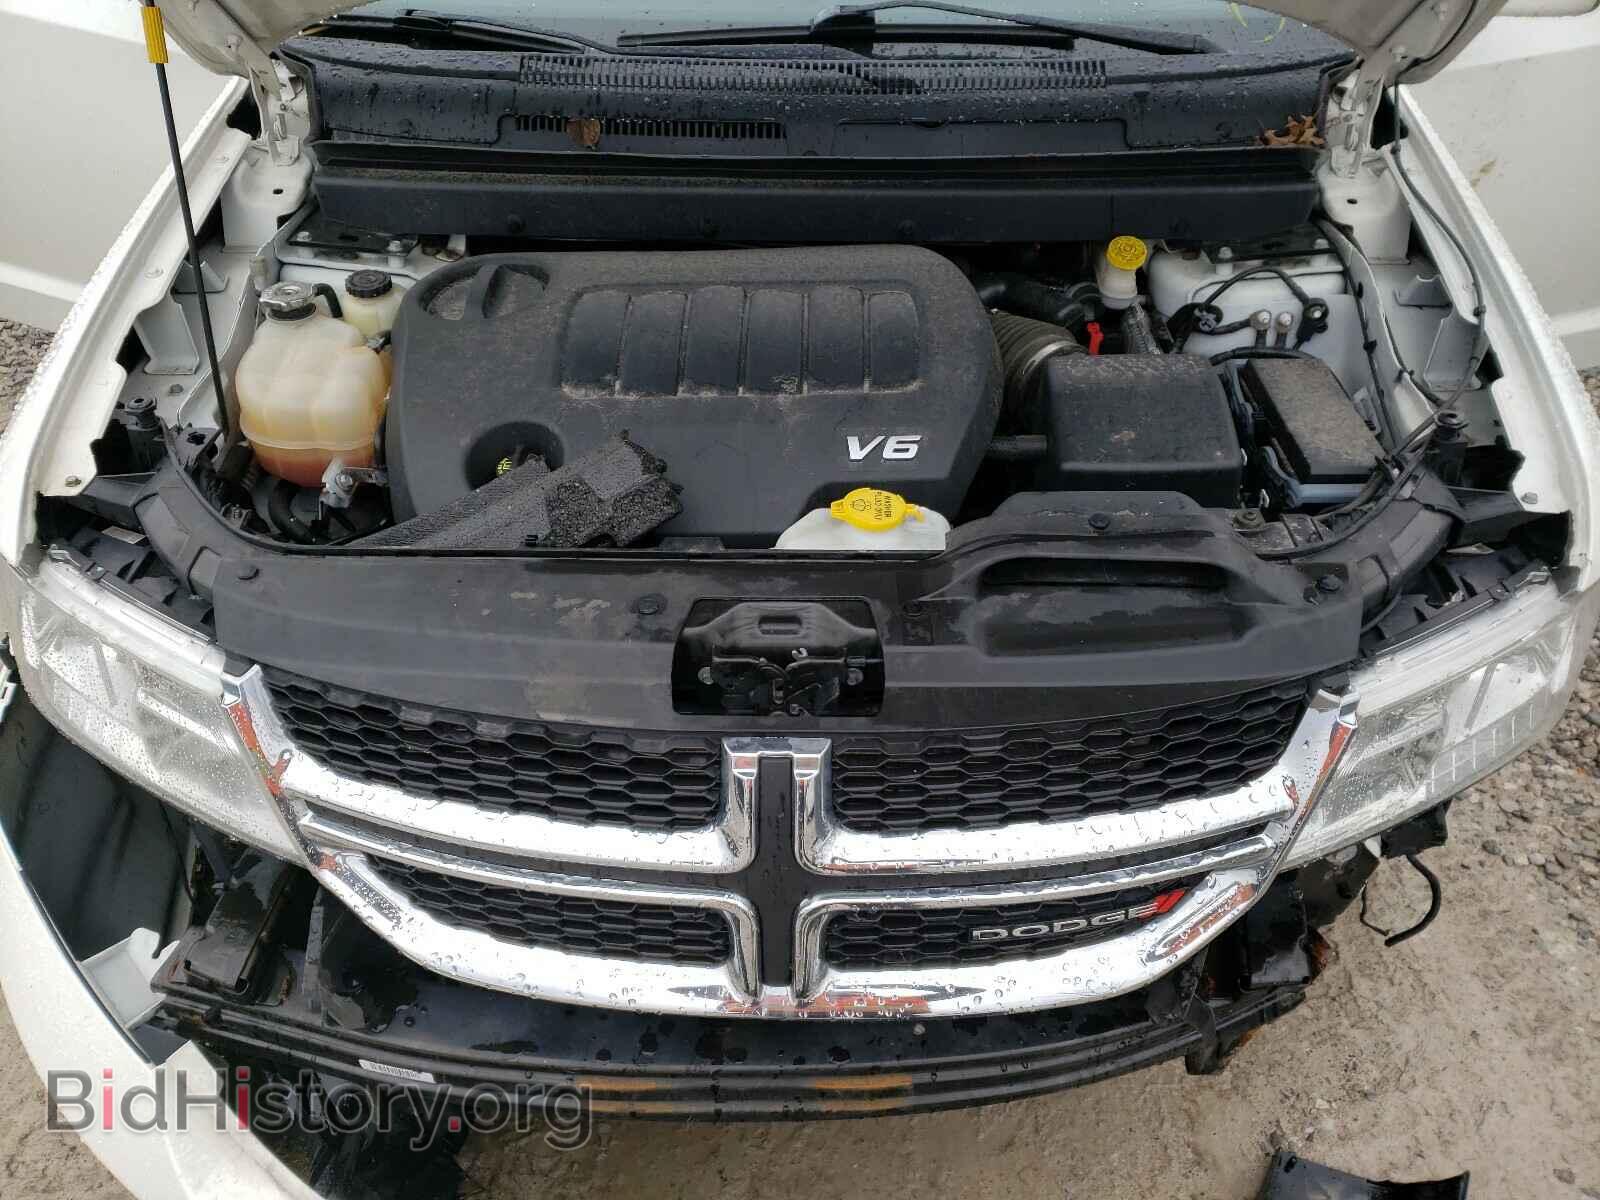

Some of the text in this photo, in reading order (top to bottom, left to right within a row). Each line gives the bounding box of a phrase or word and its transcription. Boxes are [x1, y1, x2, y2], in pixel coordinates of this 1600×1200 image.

[846, 435, 922, 460] V6
[884, 495, 892, 517] WASHER
[972, 902, 1159, 941] DODGE
